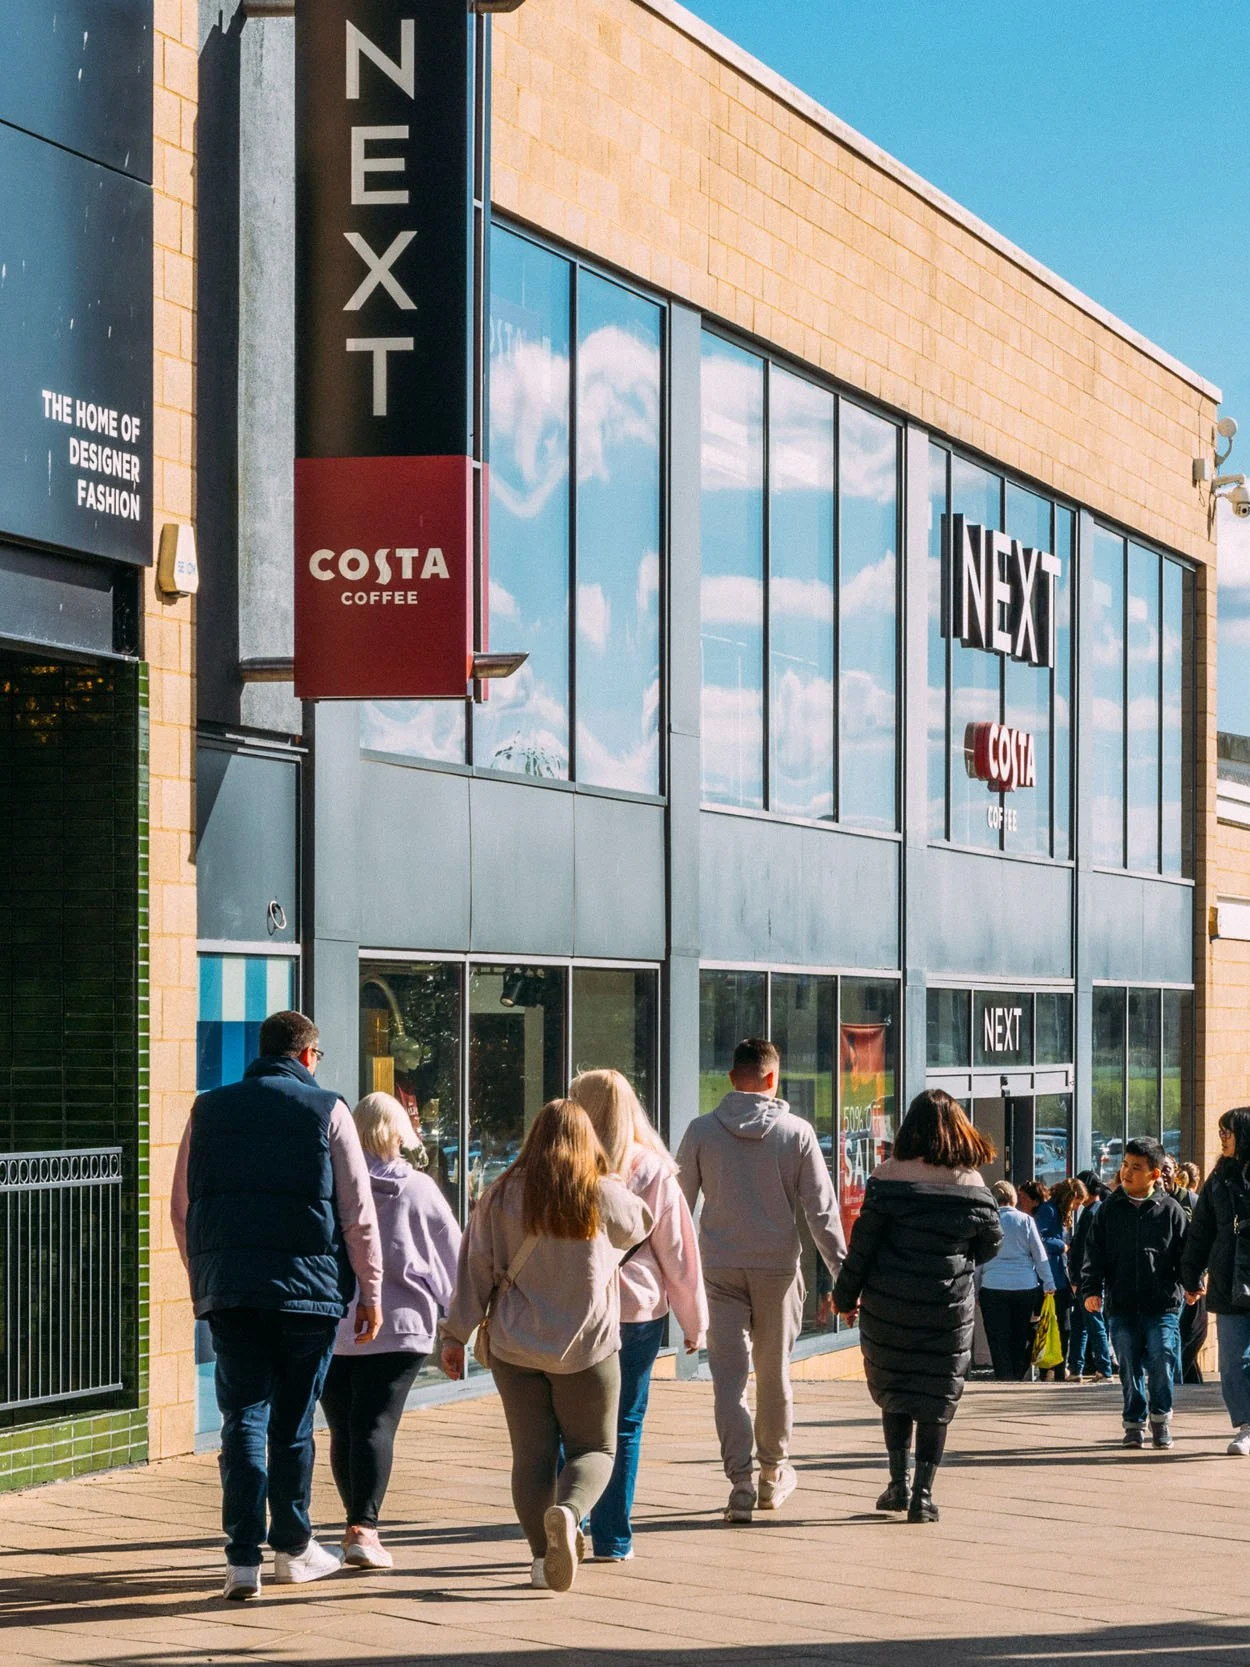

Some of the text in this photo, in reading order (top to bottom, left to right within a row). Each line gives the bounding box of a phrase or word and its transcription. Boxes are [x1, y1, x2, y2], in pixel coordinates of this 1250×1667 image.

[342, 19, 418, 417] NEXT
[41, 389, 140, 443] THE HOME OF
[69, 437, 140, 483] DESIGNER
[77, 479, 140, 521] FASHION
[309, 547, 450, 585] COSTA
[341, 591, 418, 606] COFFEE
[961, 513, 1062, 669] NEXT
[988, 722, 1036, 791] COSTA
[984, 1007, 1022, 1052] NEXT
